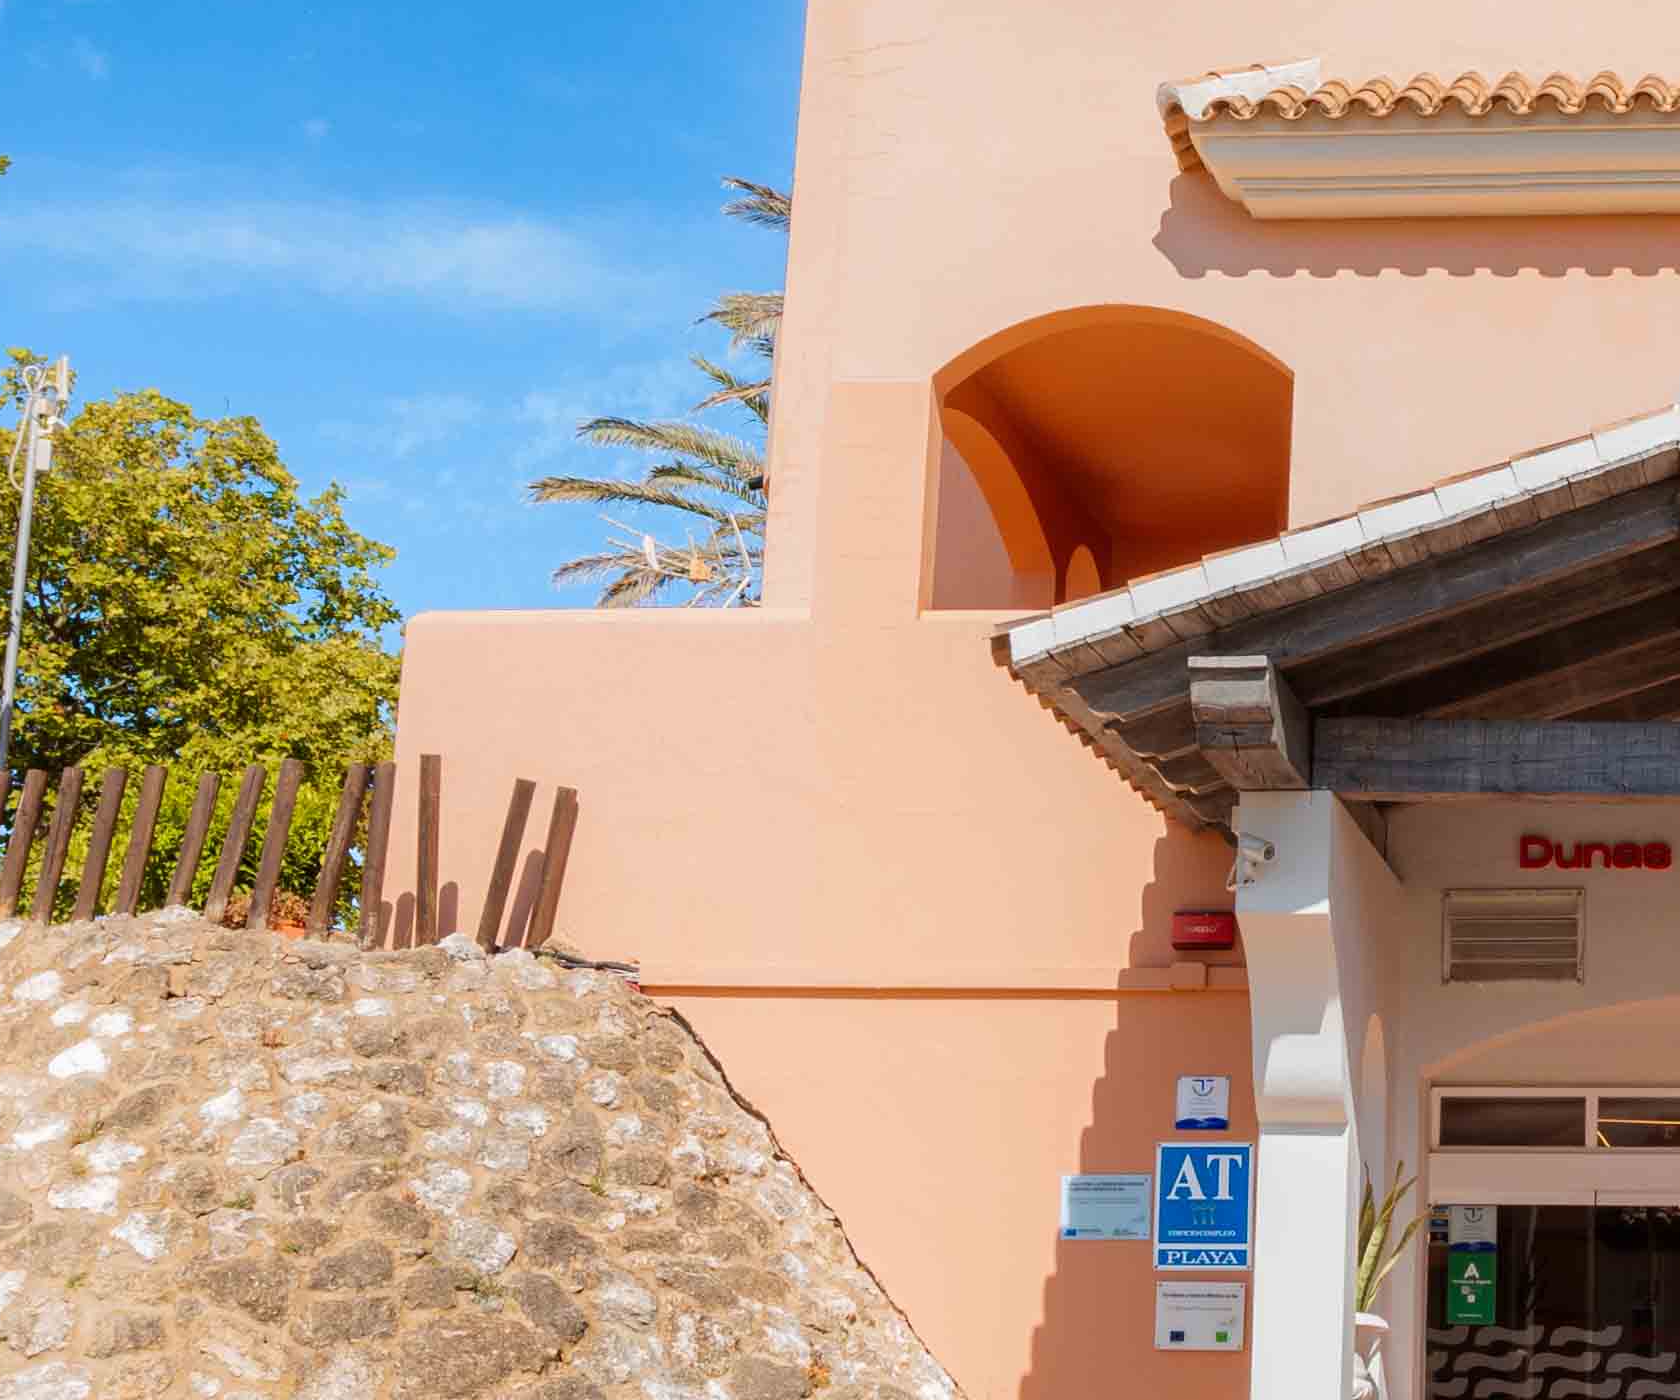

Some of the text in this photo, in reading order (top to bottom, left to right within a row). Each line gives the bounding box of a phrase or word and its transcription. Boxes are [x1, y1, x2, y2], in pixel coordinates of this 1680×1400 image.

[1519, 834, 1672, 869] Dunas
[1166, 1153, 1242, 1200] AT
[1166, 1251, 1238, 1265] PLAYA
